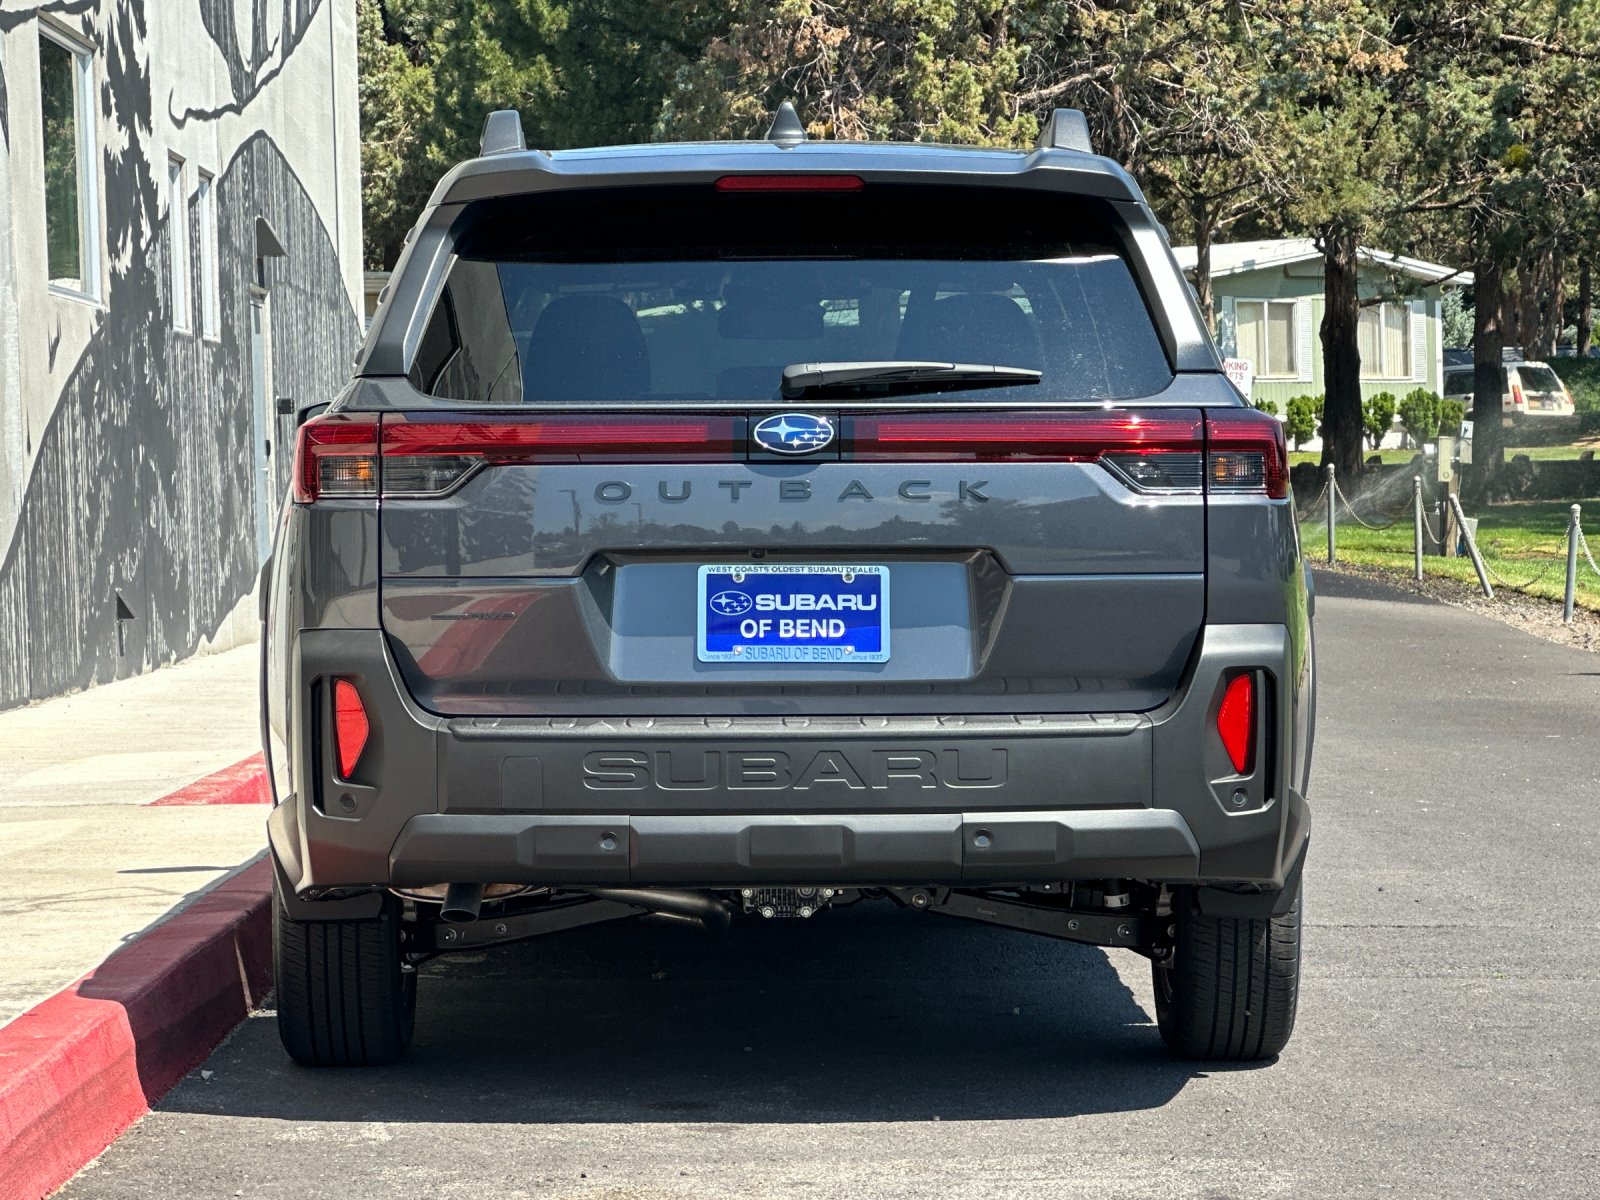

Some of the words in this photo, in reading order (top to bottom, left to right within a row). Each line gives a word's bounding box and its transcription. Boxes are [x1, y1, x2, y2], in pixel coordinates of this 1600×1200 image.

[594, 480, 989, 502] OUTBACK
[755, 594, 877, 611] SUBARU
[740, 619, 773, 638] OF
[779, 619, 845, 638] BEND
[745, 646, 791, 660] SUBARU
[794, 647, 809, 660] OF
[812, 647, 843, 660] BEND
[582, 749, 1009, 791] SUBARU
